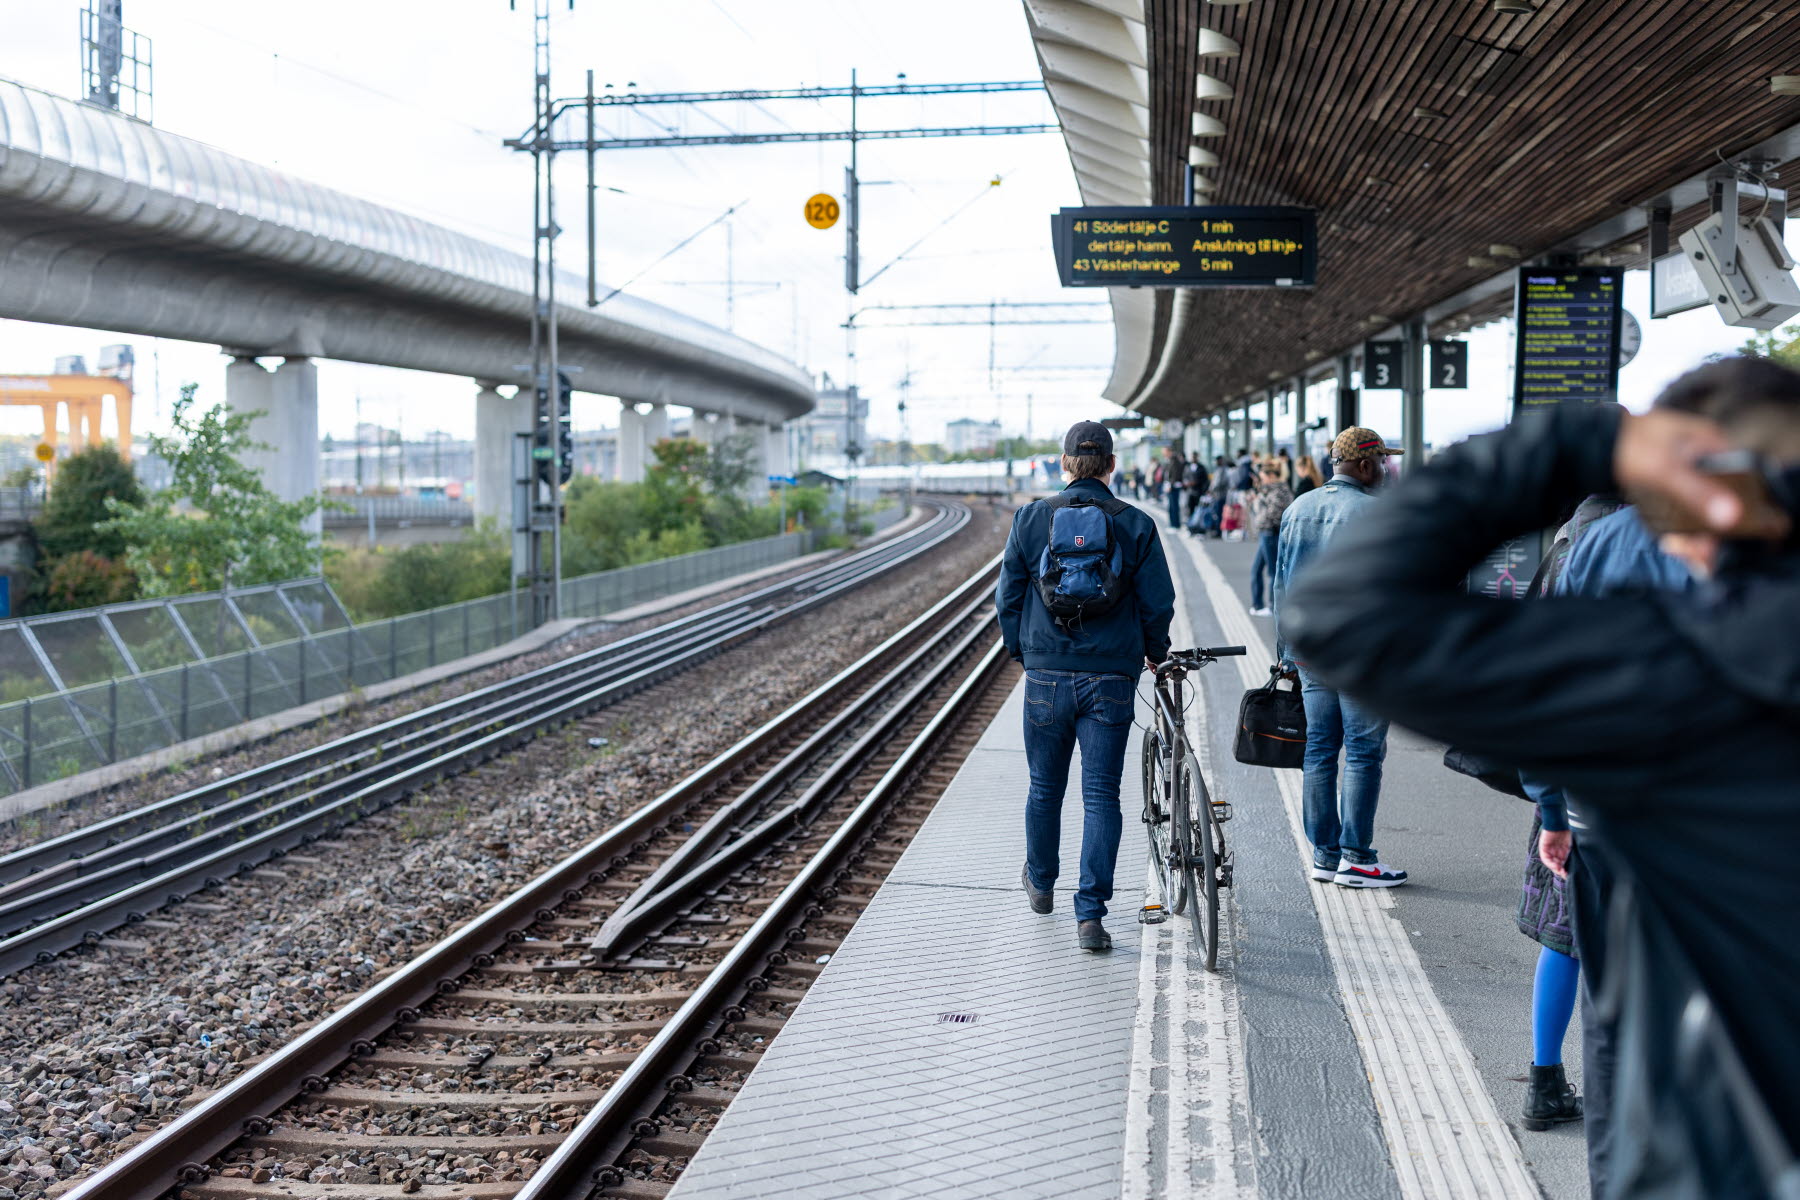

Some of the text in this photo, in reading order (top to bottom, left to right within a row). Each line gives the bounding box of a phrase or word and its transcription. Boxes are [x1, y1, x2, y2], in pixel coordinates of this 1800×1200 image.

[807, 202, 839, 221] 120
[1074, 220, 1233, 236] 41 Södertälje C 1 min
[1192, 239, 1256, 255] Anslutning
[1258, 239, 1271, 252] till
[1272, 239, 1296, 255] linje
[1073, 258, 1233, 274] 43 Västerhaninge 5 min
[1376, 364, 1389, 385] 3
[1443, 364, 1456, 385] 2
